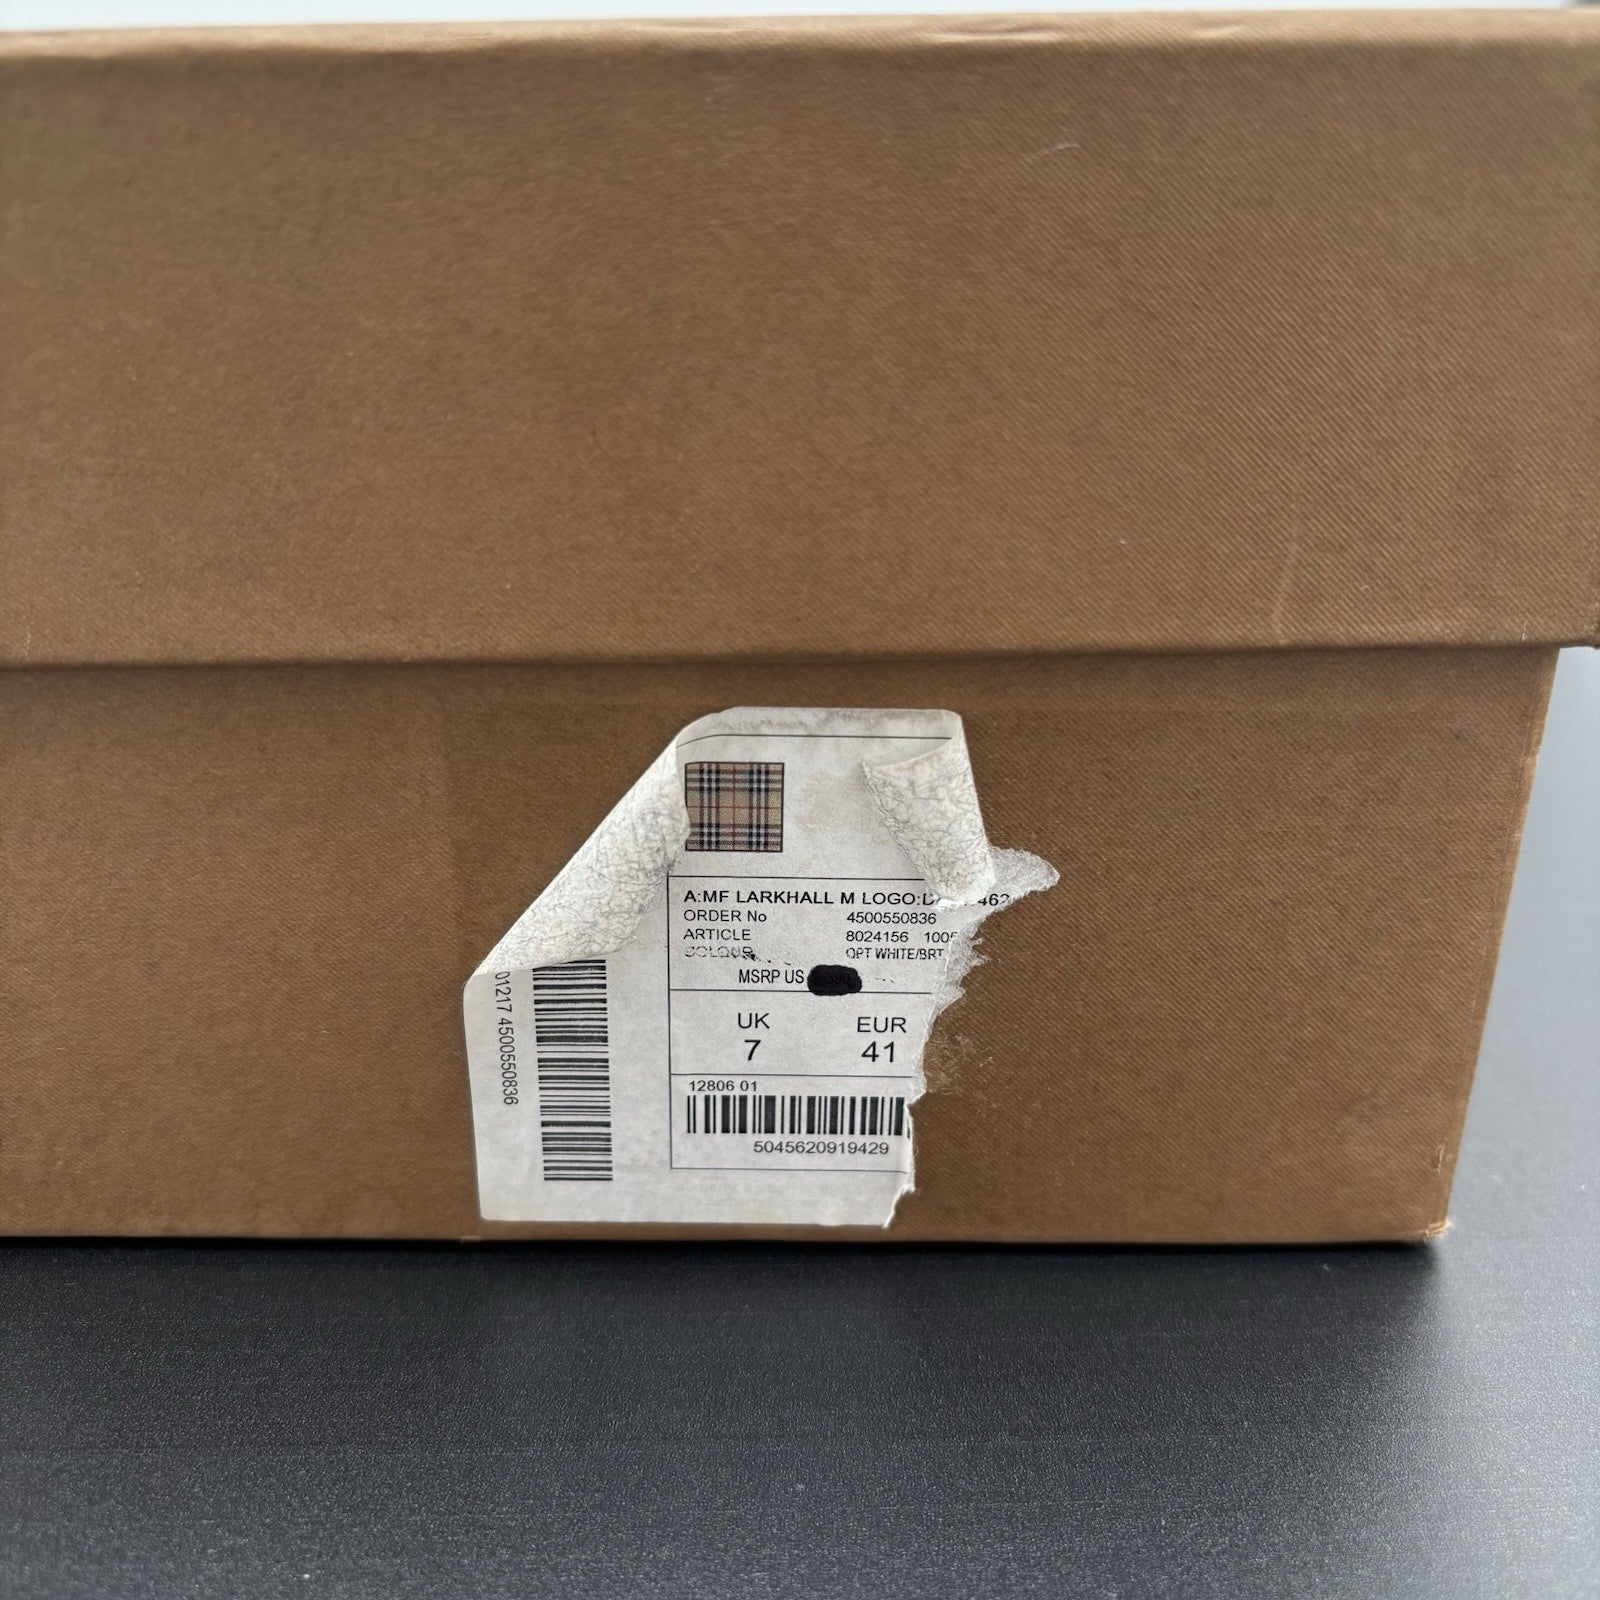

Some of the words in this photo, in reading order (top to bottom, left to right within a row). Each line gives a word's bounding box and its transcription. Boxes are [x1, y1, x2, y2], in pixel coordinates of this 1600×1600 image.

[683, 889, 730, 903] A:MF
[736, 890, 834, 905] LARKHALL
[840, 892, 855, 905] M
[683, 909, 742, 922] ORDER
[747, 910, 768, 923] No
[846, 911, 938, 925] 4500550836
[683, 928, 752, 941] ARTICLE
[845, 930, 910, 943] 8024156
[738, 969, 781, 984] MSRP
[784, 969, 805, 984] US
[494, 971, 513, 1013] 01217
[737, 1012, 771, 1029] UK
[856, 1016, 907, 1033] EUR
[744, 1039, 762, 1061] 7
[861, 1040, 895, 1063] 41
[497, 1017, 519, 1106] 4500550836
[688, 1080, 735, 1092] 12806
[740, 1080, 757, 1092] 01
[753, 1140, 890, 1155] 5045620919429
